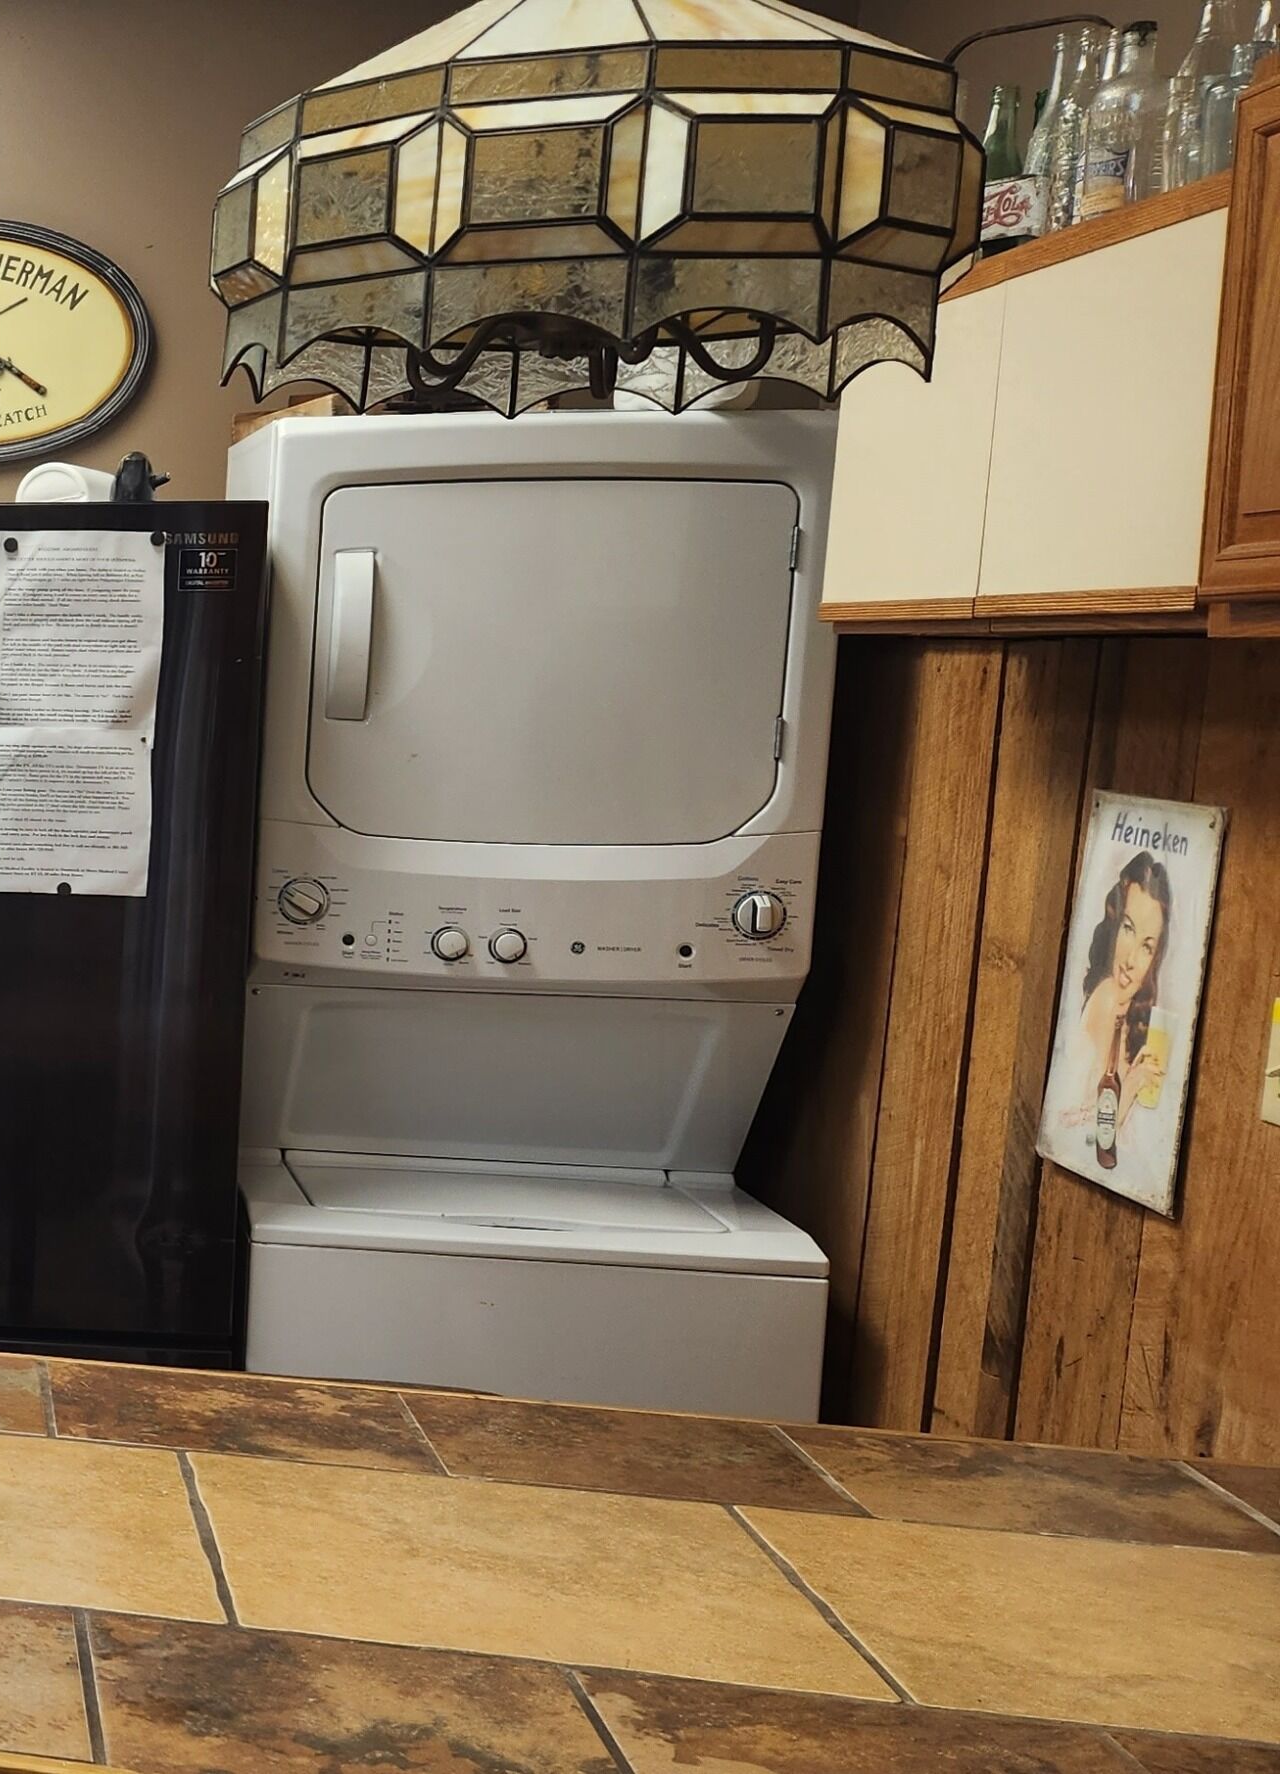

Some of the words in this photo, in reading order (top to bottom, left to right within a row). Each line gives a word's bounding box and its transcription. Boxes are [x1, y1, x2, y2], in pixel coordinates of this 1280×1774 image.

[165, 532, 239, 545] SAMSUNG
[198, 551, 218, 568] 10
[1111, 811, 1188, 856] Heineken
